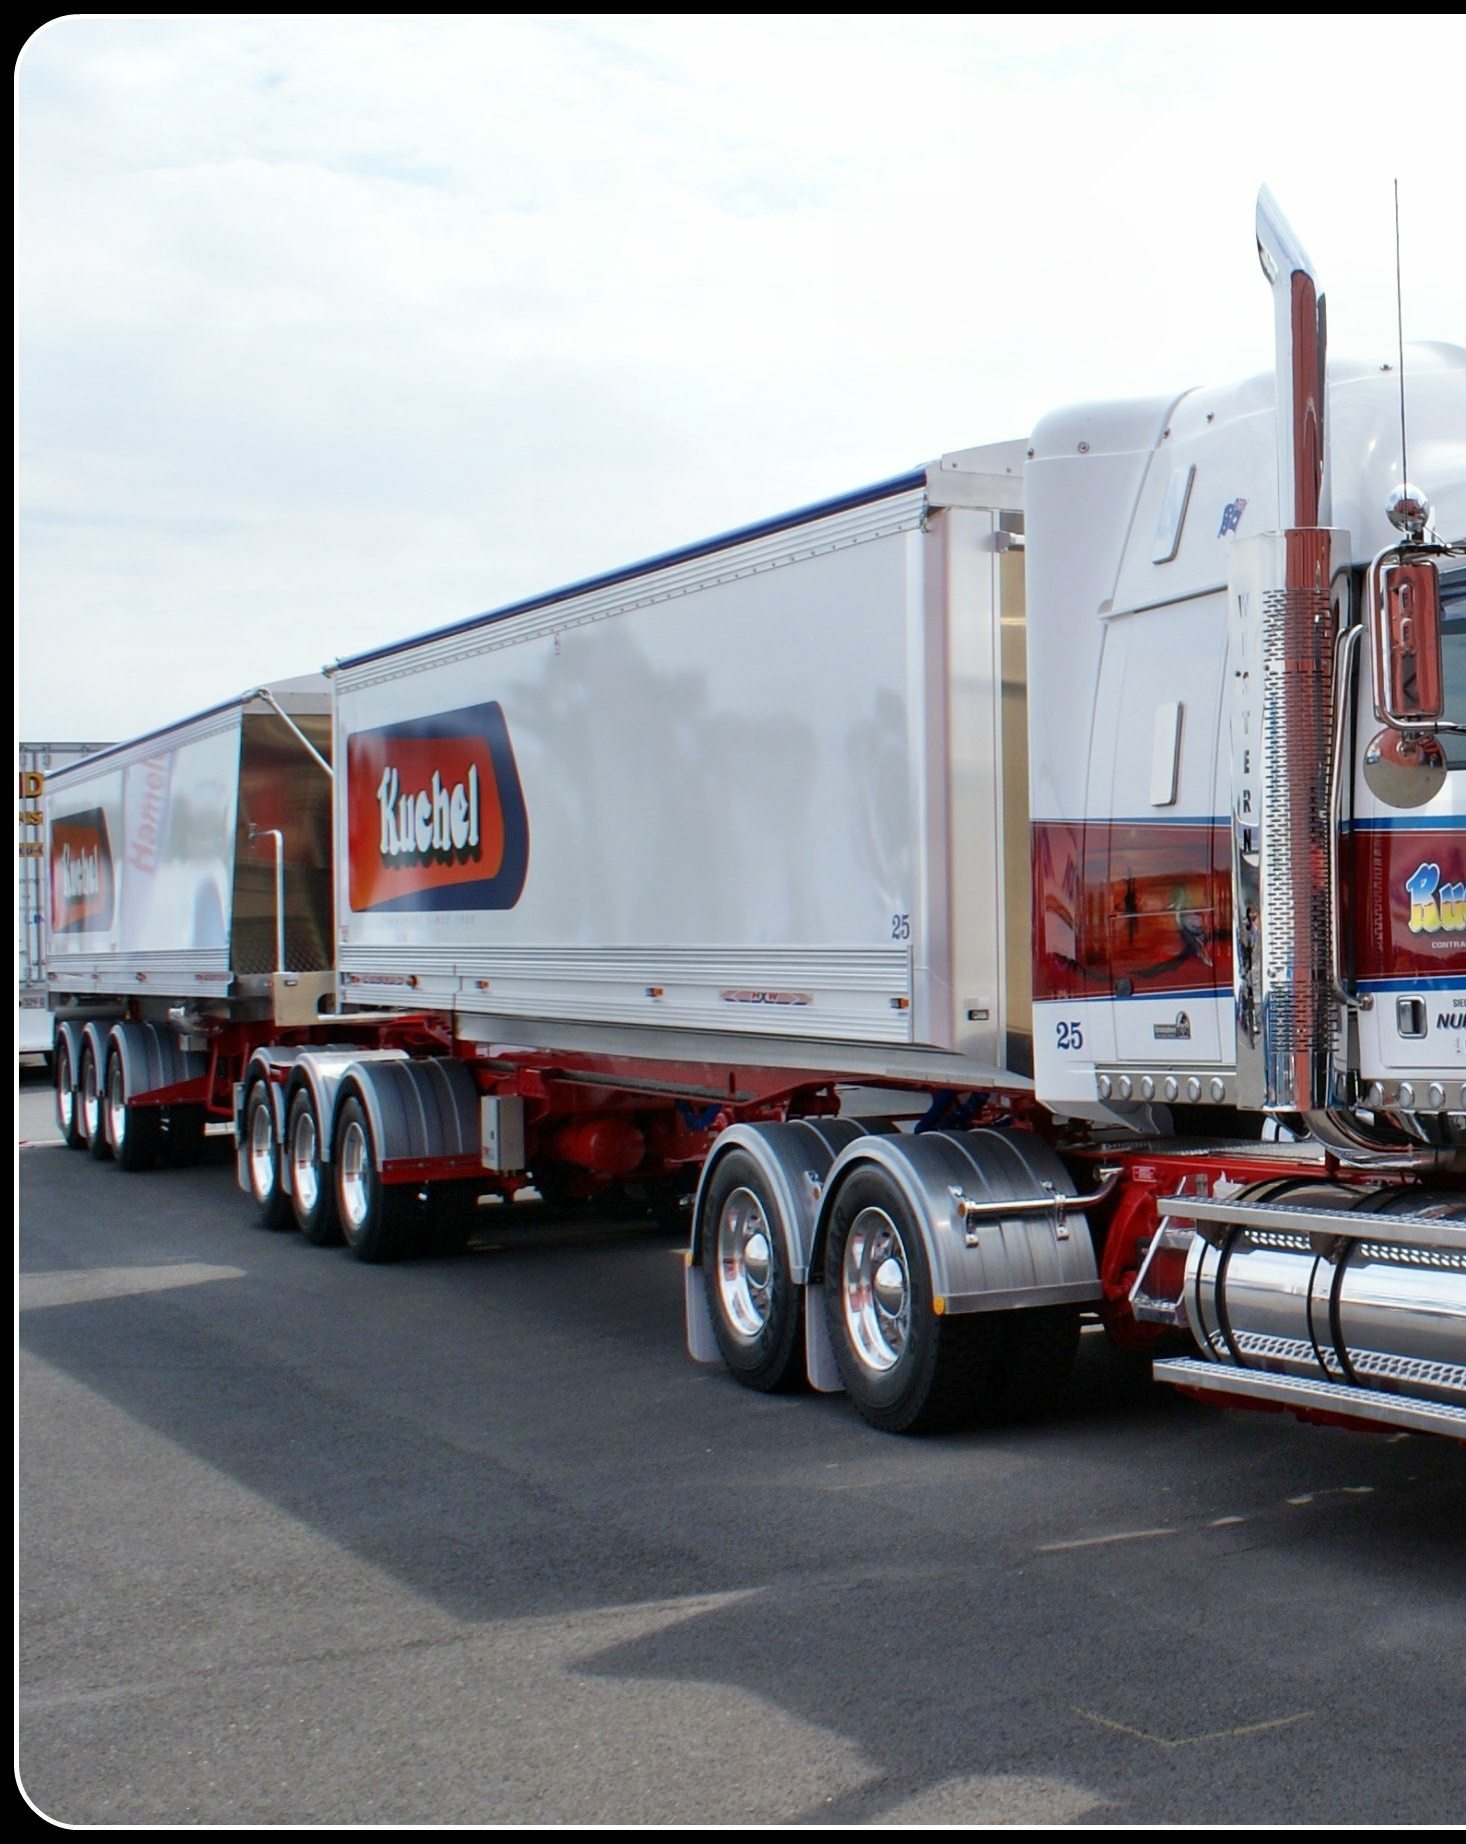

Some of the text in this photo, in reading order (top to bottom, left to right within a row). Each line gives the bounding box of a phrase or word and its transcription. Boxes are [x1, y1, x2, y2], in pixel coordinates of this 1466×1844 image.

[377, 762, 482, 859] Kuchel
[892, 914, 910, 940] 25
[1056, 1021, 1083, 1050] 25
